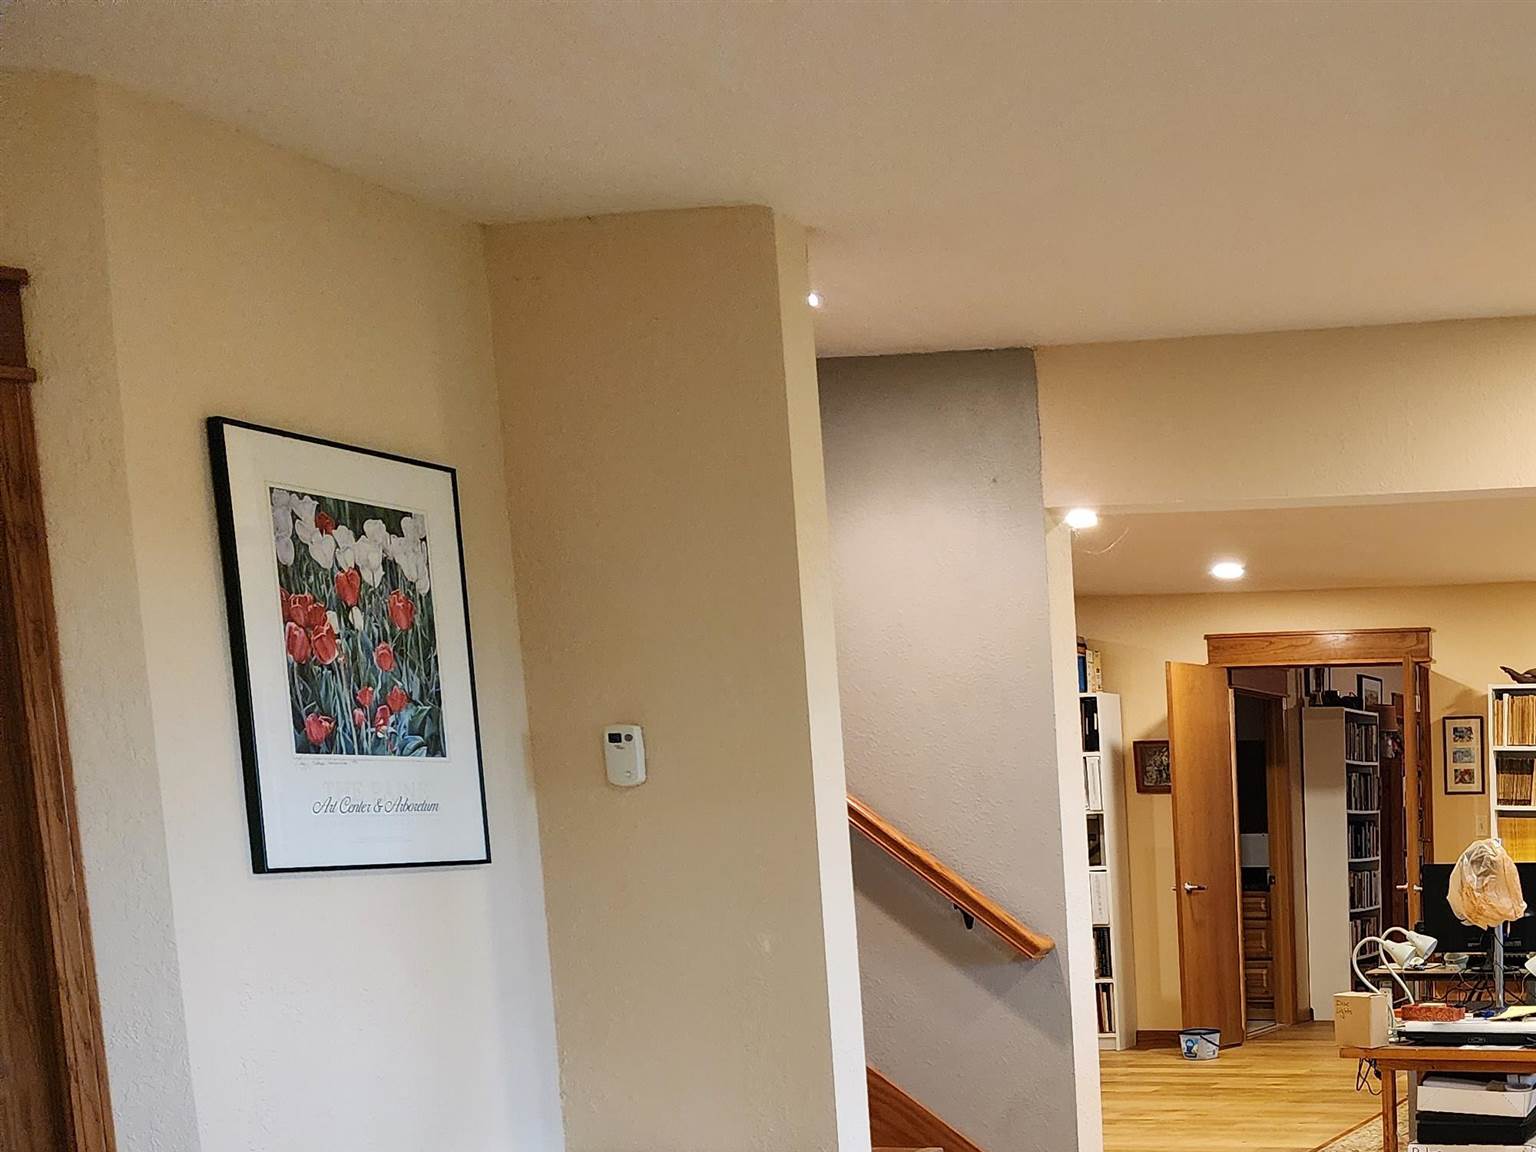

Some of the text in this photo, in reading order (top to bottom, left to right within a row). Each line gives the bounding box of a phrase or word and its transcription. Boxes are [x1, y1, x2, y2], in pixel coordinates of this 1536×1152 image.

[312, 795, 440, 814] Art Center & Arboretum
